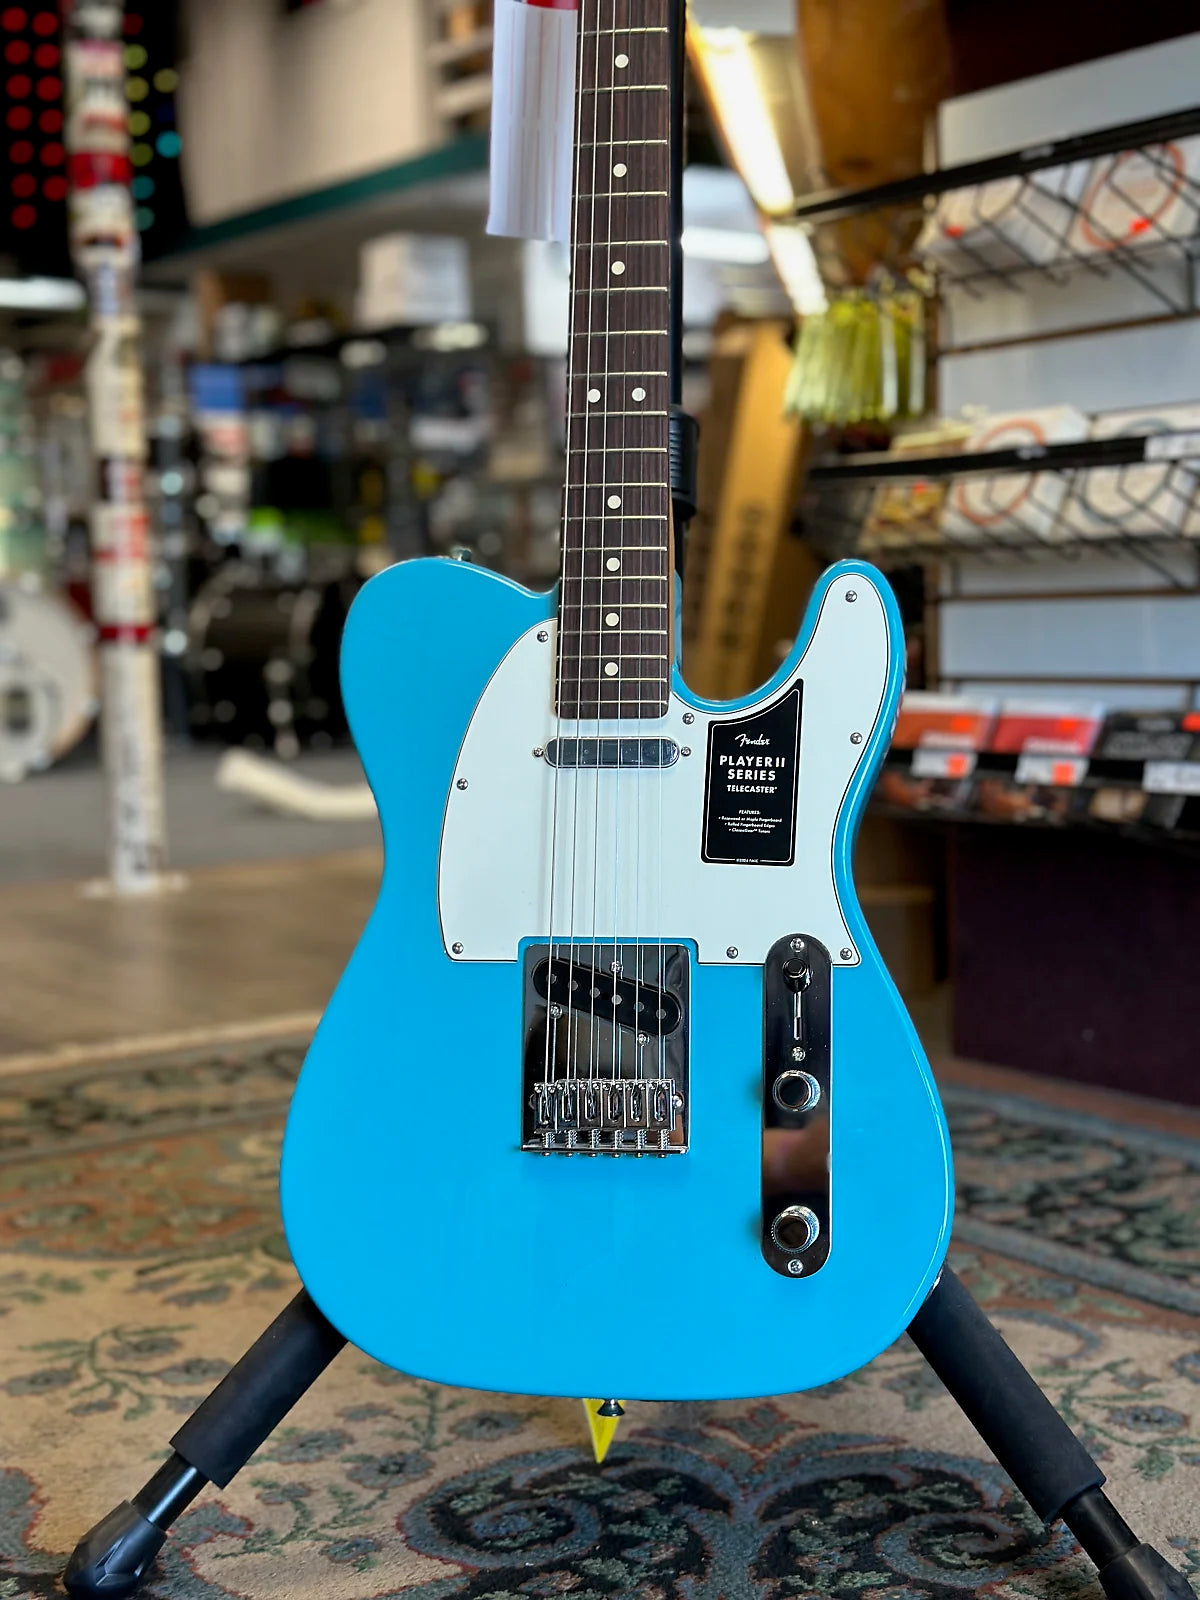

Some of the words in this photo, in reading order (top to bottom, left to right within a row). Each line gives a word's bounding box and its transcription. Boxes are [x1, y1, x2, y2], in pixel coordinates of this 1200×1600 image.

[734, 733, 771, 748] Fender
[719, 754, 773, 768] PLAYER
[775, 756, 786, 768] II
[727, 768, 776, 782] SERIES
